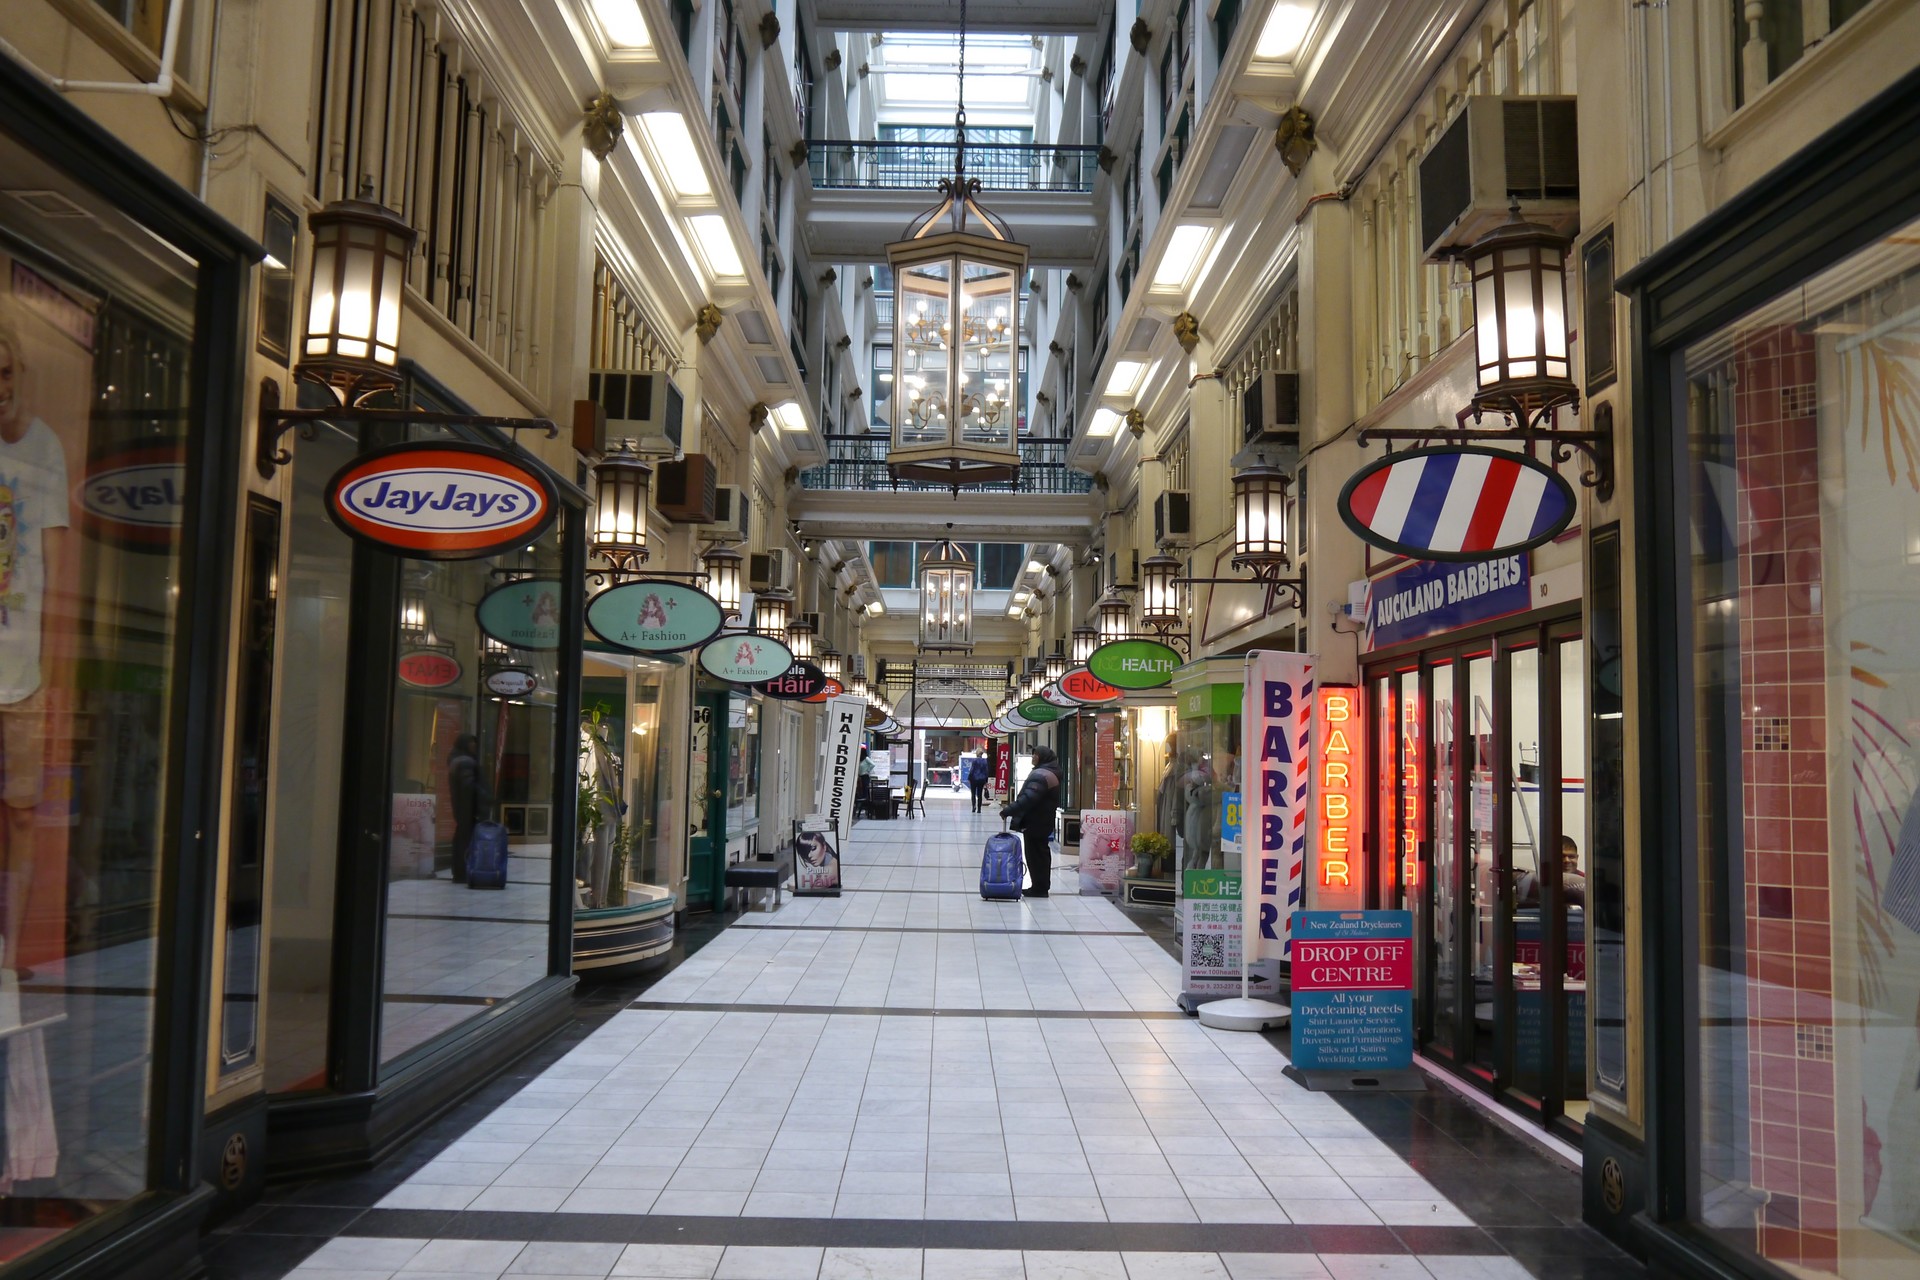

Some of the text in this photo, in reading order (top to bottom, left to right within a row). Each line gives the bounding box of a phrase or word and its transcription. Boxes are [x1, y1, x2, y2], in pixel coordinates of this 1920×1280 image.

[362, 481, 519, 518] JayJays
[1377, 554, 1521, 628] AUCKLAND BARBERS
[620, 630, 687, 642] A+ Fashion
[788, 665, 805, 675] ula
[1122, 658, 1173, 673] HEALTH
[767, 676, 814, 693] Hair
[829, 712, 853, 824] HAIRDRESSE
[1000, 750, 1009, 789] HAIR
[1325, 697, 1350, 886] BARBER
[1259, 681, 1293, 940] BARBER
[1085, 814, 1112, 824] Facial
[1098, 826, 1112, 834] Skin
[806, 867, 830, 875] Paula
[802, 875, 836, 889] Hair
[1311, 920, 1402, 930] New Zealand Drycleaners
[1300, 946, 1404, 962] DROP OFF
[1311, 967, 1393, 982] CENTRE
[1331, 993, 1373, 1005] All your
[1301, 1004, 1403, 1017] Drycleaning needs
[1303, 1028, 1335, 1036] Repairs
[1357, 1026, 1401, 1034] Alterations
[1353, 1036, 1403, 1044] Furnishings
[1361, 1045, 1386, 1053] Satins
[1317, 1055, 1355, 1064] Wedding
